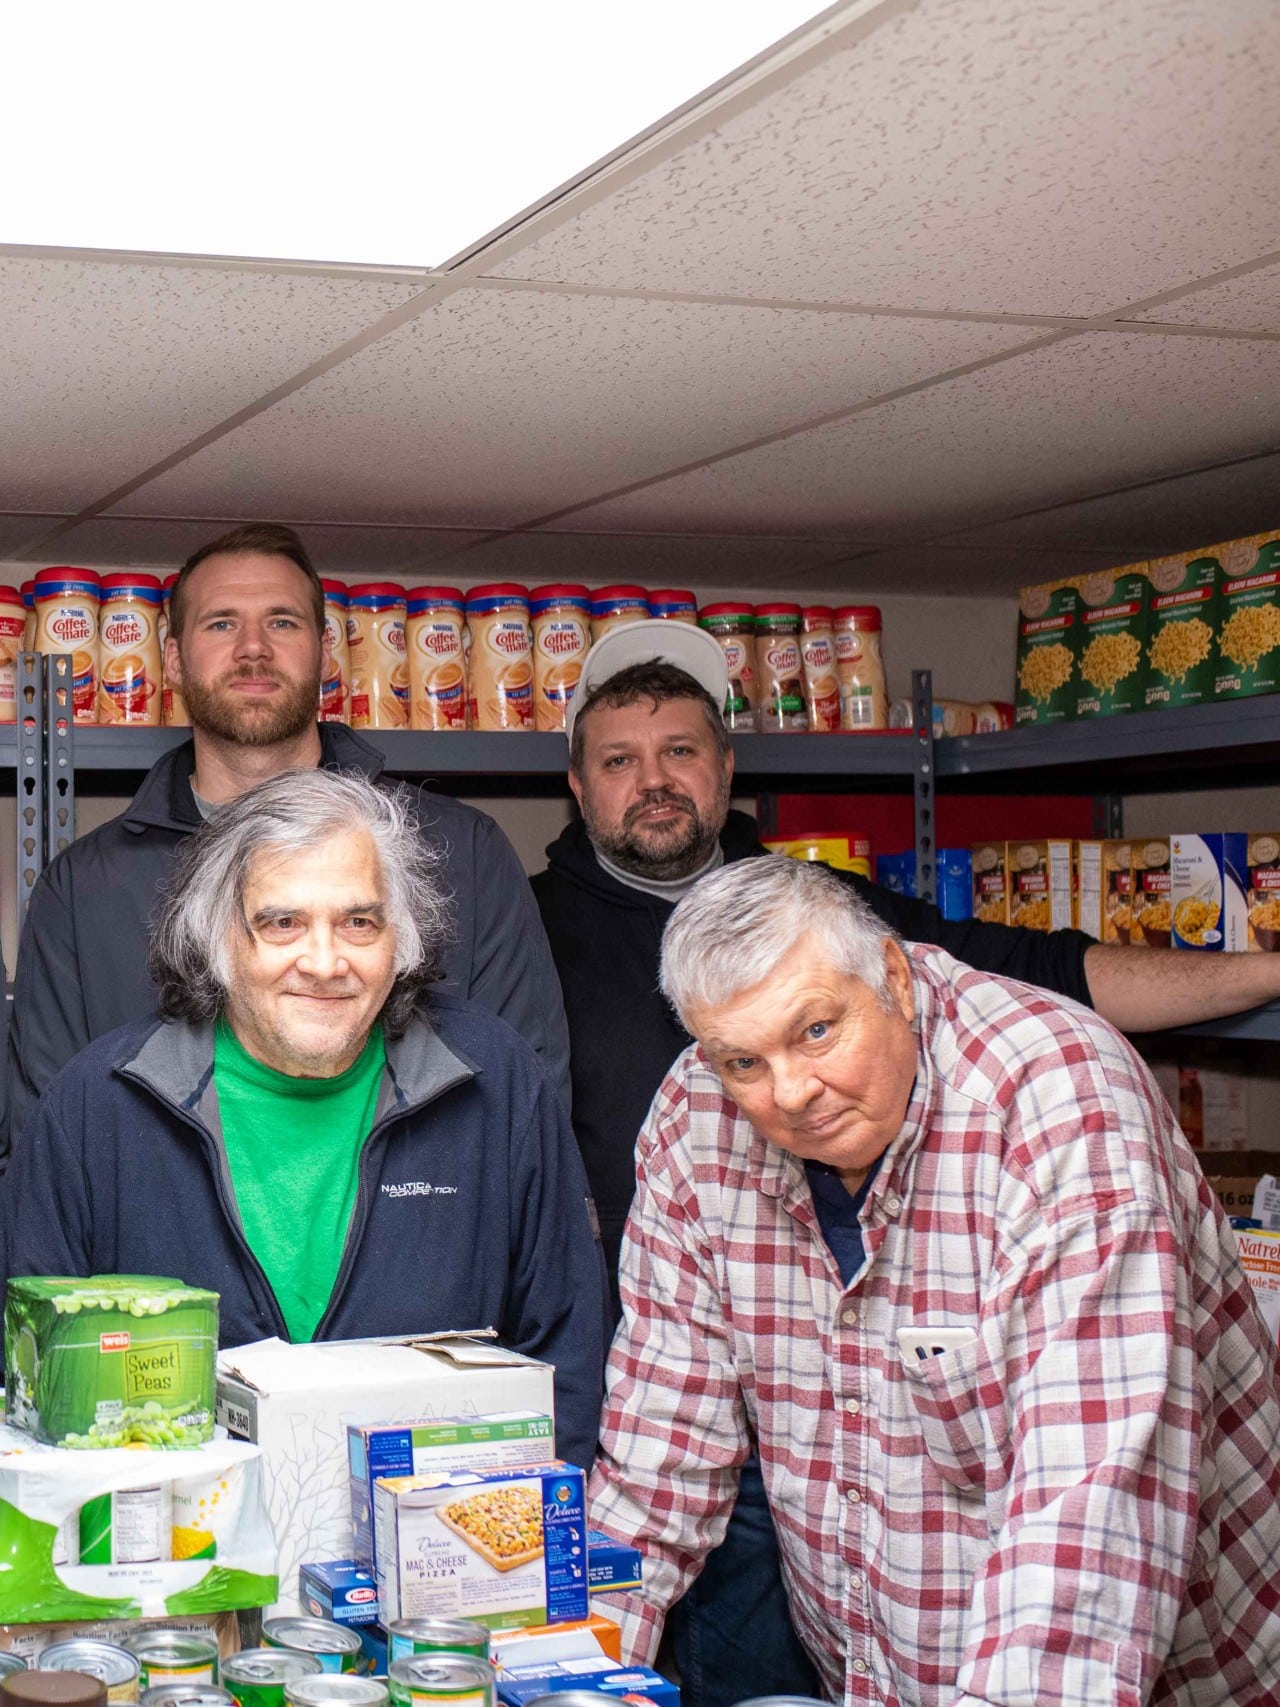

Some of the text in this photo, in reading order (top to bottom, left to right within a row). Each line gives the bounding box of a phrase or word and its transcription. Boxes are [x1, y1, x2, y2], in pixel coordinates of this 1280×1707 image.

[53, 618, 87, 635] Coffee
[62, 628, 90, 641] mate
[106, 622, 139, 640] Coffee
[113, 632, 142, 646] mate
[425, 632, 455, 649] Coffee
[495, 631, 526, 648] Coffee
[544, 631, 577, 649] Coffee
[553, 641, 581, 654] mate
[434, 642, 459, 655] mate
[381, 1181, 432, 1193] NAUTICA
[128, 1351, 177, 1375] Sweet
[133, 1374, 173, 1392] Peas
[544, 1503, 583, 1521] Deluxe
[417, 1536, 452, 1553] Deluxe
[405, 1554, 469, 1572] MAC & CHEESE
[419, 1568, 457, 1579] PIZZA
[342, 1607, 365, 1615] GLUTEN
[190, 1623, 212, 1632] Facts
